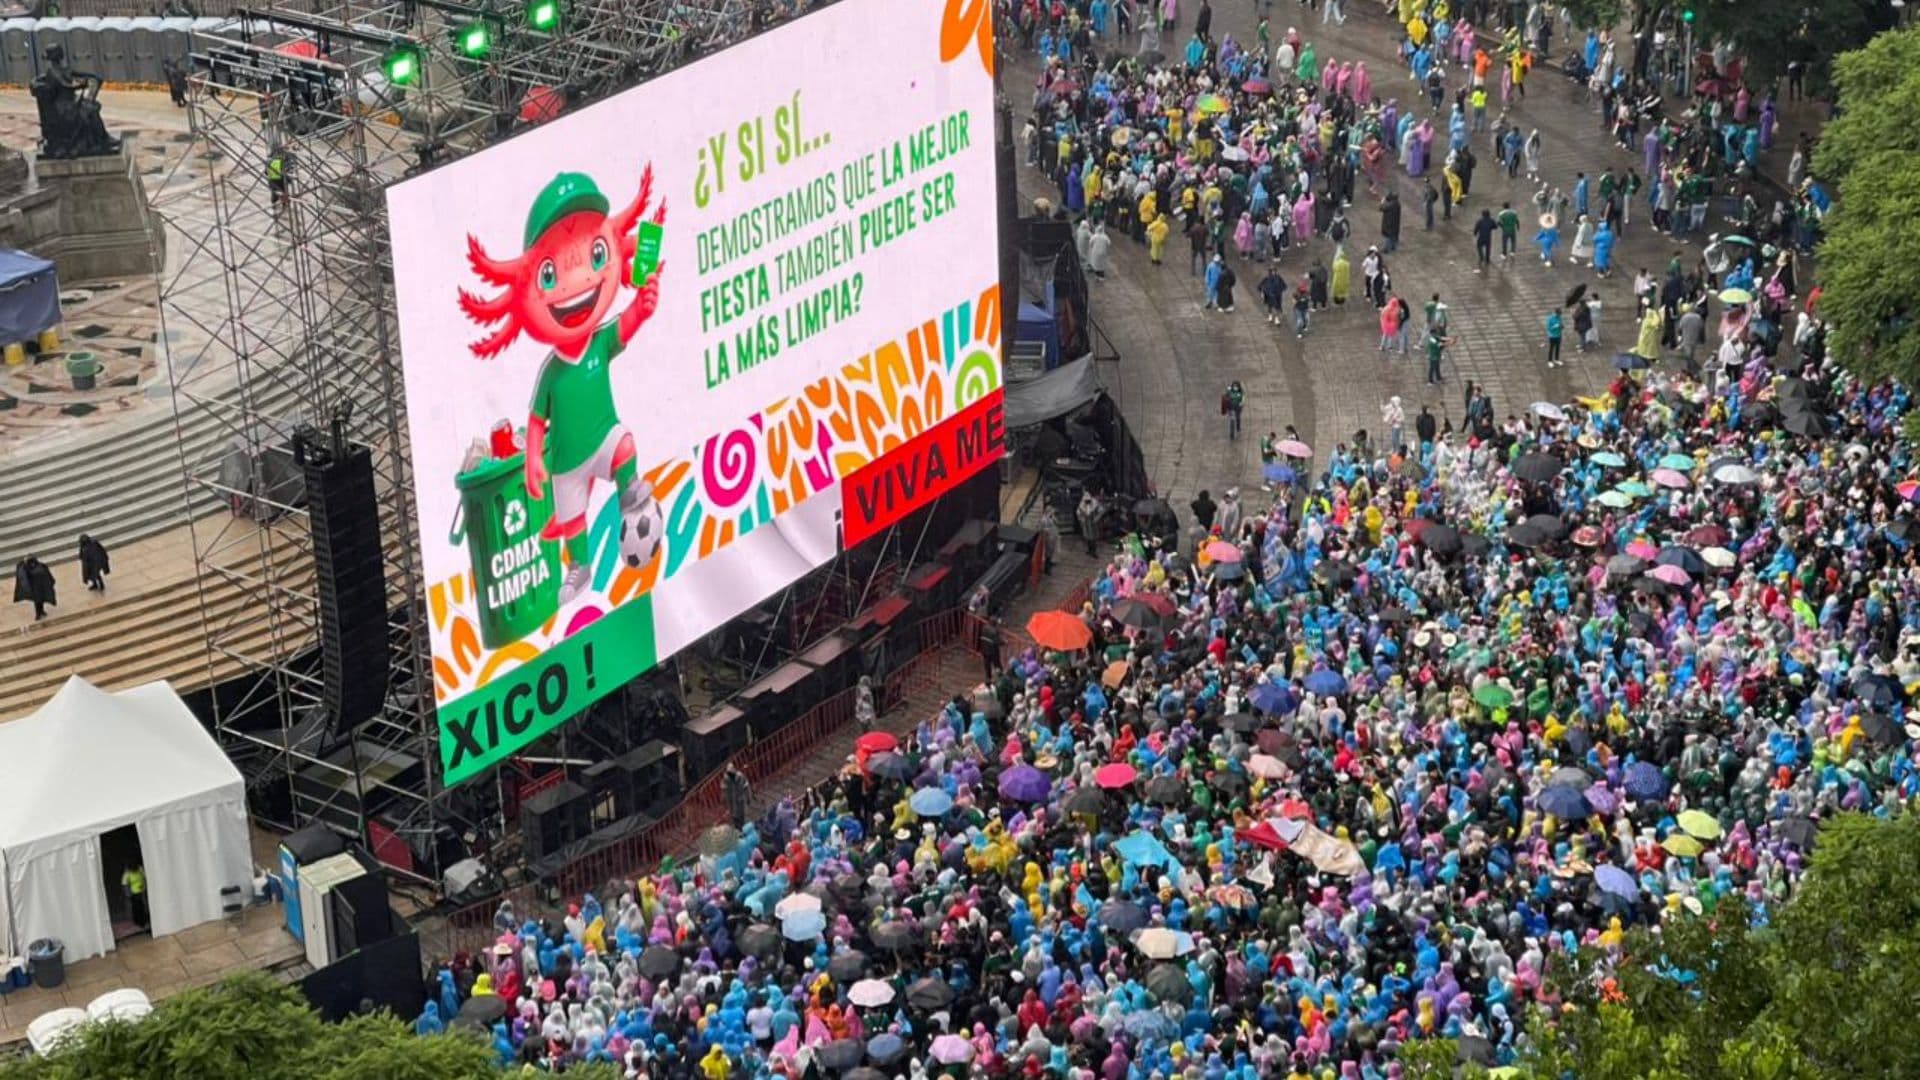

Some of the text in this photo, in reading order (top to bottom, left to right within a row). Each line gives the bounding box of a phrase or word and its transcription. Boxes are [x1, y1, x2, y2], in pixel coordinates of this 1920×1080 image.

[694, 132, 726, 208] ¿Y
[737, 117, 765, 182] SI
[697, 110, 970, 275] DEMOSTRAMOS QUE LA MEJOR
[700, 172, 956, 333] FIESTA TAMBIÉN PUEDE SER
[704, 272, 863, 389] LA MÁS LIMPIA?
[956, 405, 1005, 470] ME
[487, 559, 550, 609] LIMPIA
[491, 533, 543, 579] CDMX
